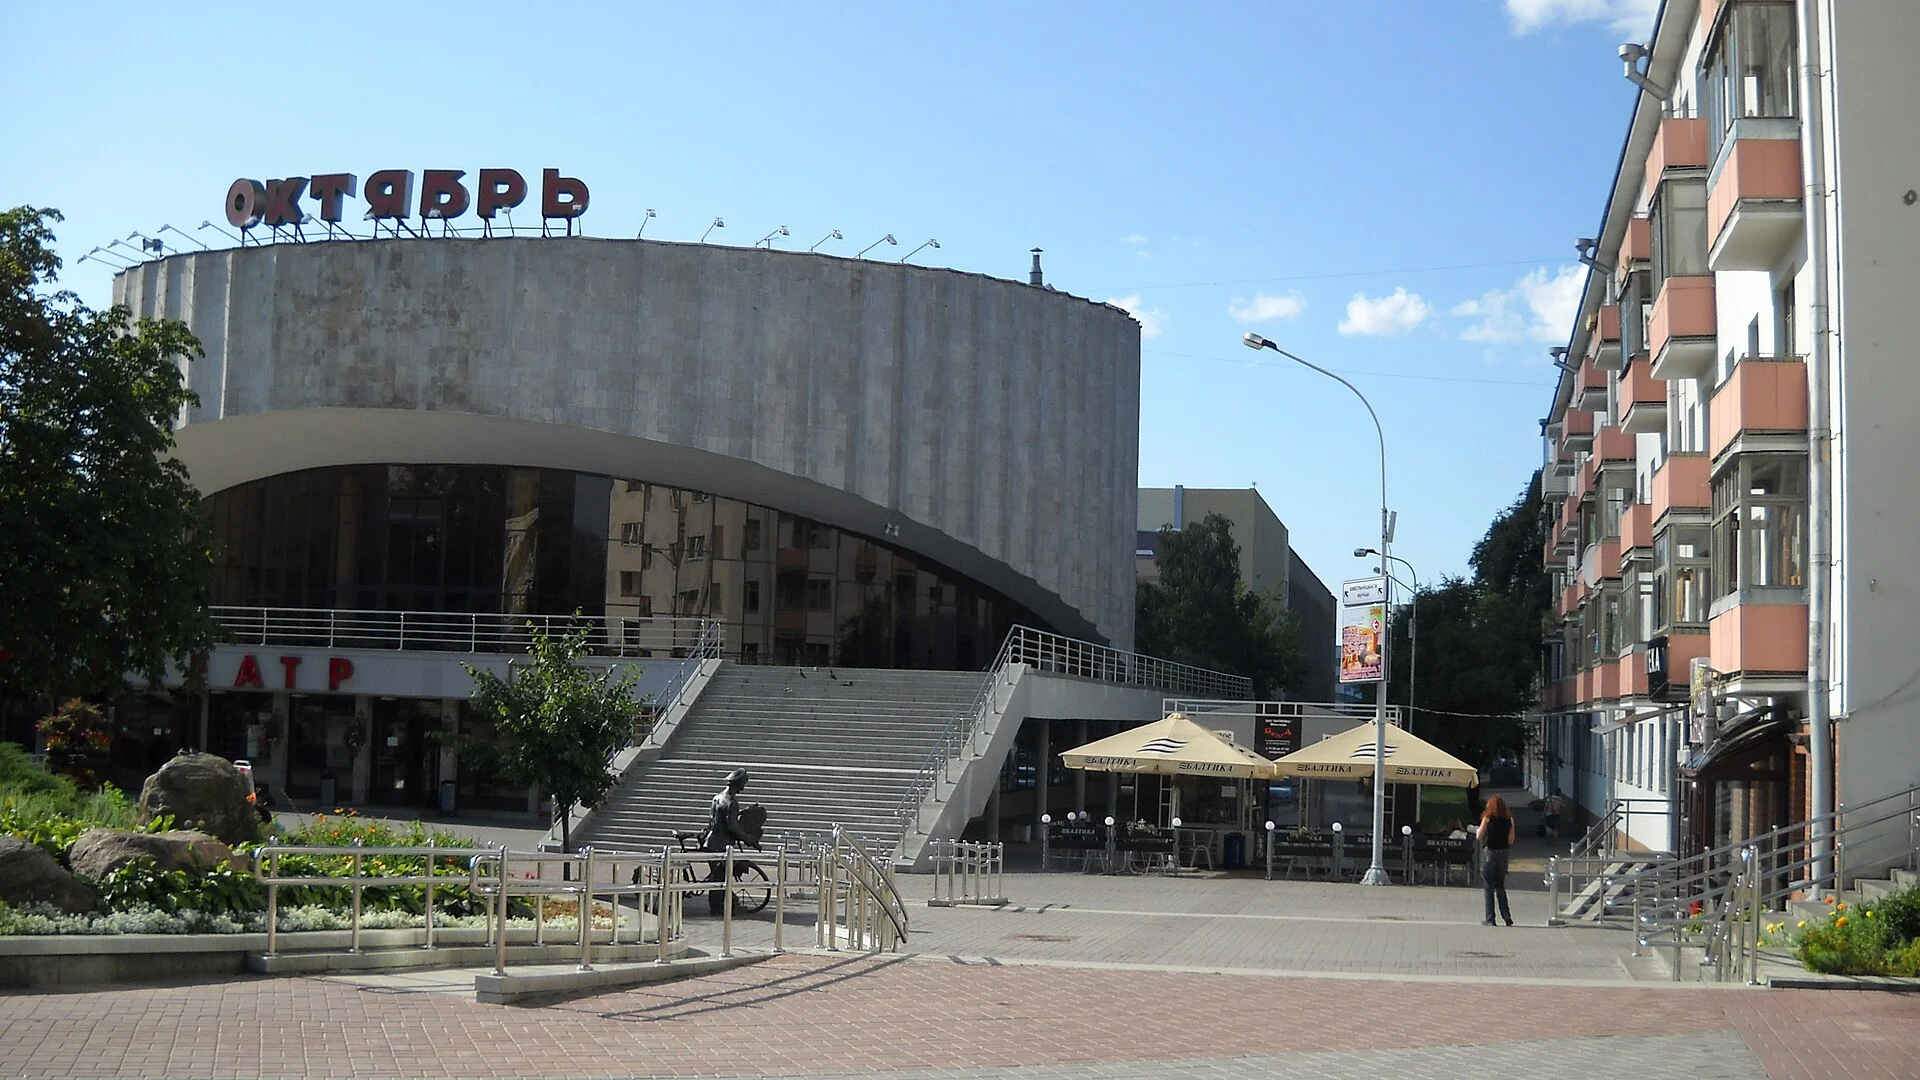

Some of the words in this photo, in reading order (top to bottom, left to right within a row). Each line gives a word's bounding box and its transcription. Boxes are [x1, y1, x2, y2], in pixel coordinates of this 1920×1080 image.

[225, 167, 591, 228] ОКТЯБРЬ
[1090, 756, 1137, 766] БАЛТИКА
[1186, 762, 1233, 772] БАЛТИКА
[1304, 764, 1352, 774] БАЛТИКА
[1404, 767, 1452, 778] БАЛТИКА
